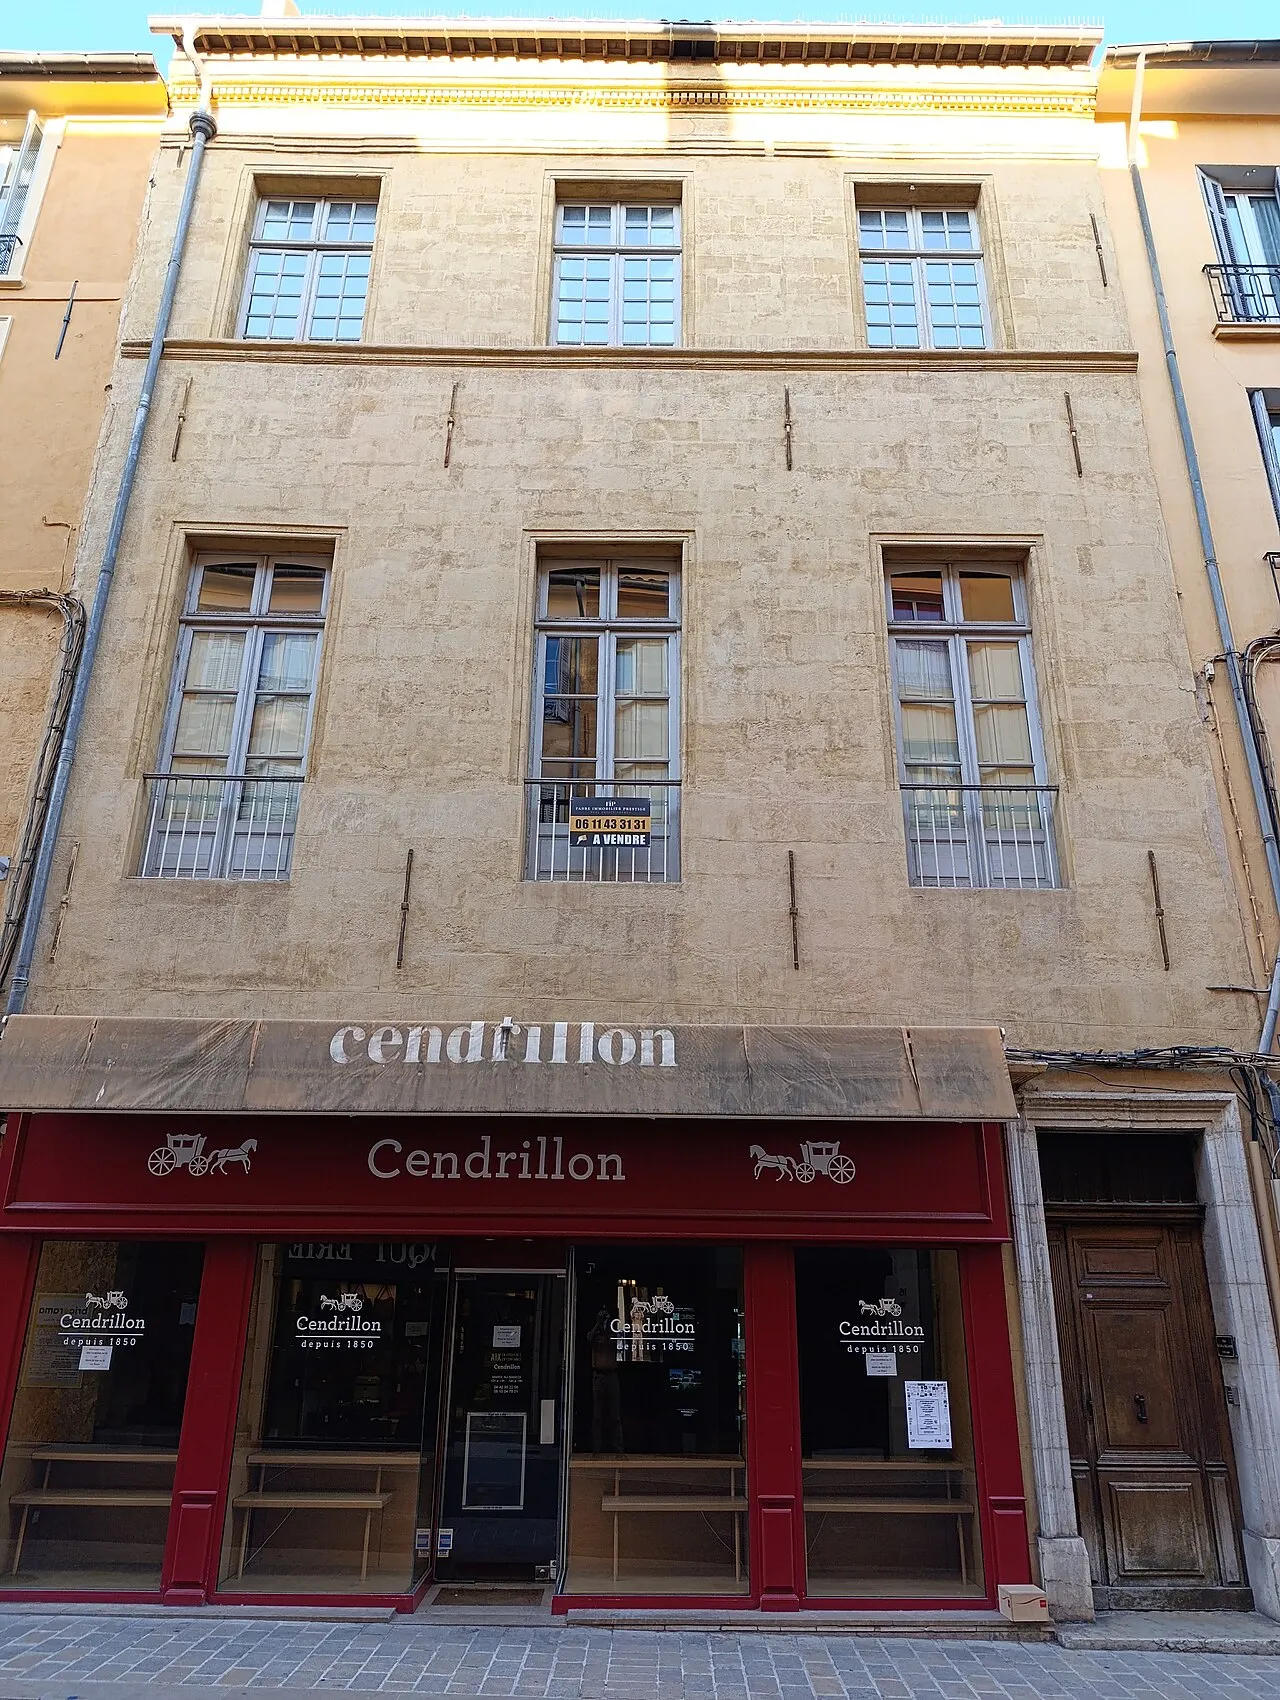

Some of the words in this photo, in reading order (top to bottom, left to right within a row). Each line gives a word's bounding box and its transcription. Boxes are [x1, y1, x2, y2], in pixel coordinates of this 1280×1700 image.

[575, 818, 589, 830] 06
[592, 819, 601, 830] 11
[603, 819, 617, 830] 43
[619, 819, 632, 830] 31
[633, 819, 646, 830] 31
[592, 834, 601, 845] A
[603, 834, 646, 845] VENDRE
[329, 1021, 679, 1067] cendrillon
[367, 1135, 626, 1181] Cendrillon
[59, 1312, 146, 1329] Cendrillon
[296, 1315, 382, 1332] Cendrillon
[610, 1317, 695, 1334] Cendrillon
[839, 1320, 925, 1336] Cendrillon
[63, 1336, 104, 1348] depuis
[109, 1336, 137, 1346] 1850
[301, 1338, 342, 1350] depuis
[347, 1339, 375, 1349] 1850
[616, 1342, 657, 1352] depuis
[662, 1342, 689, 1351] 1850
[847, 1344, 887, 1355] depuis
[892, 1344, 919, 1353] 1850
